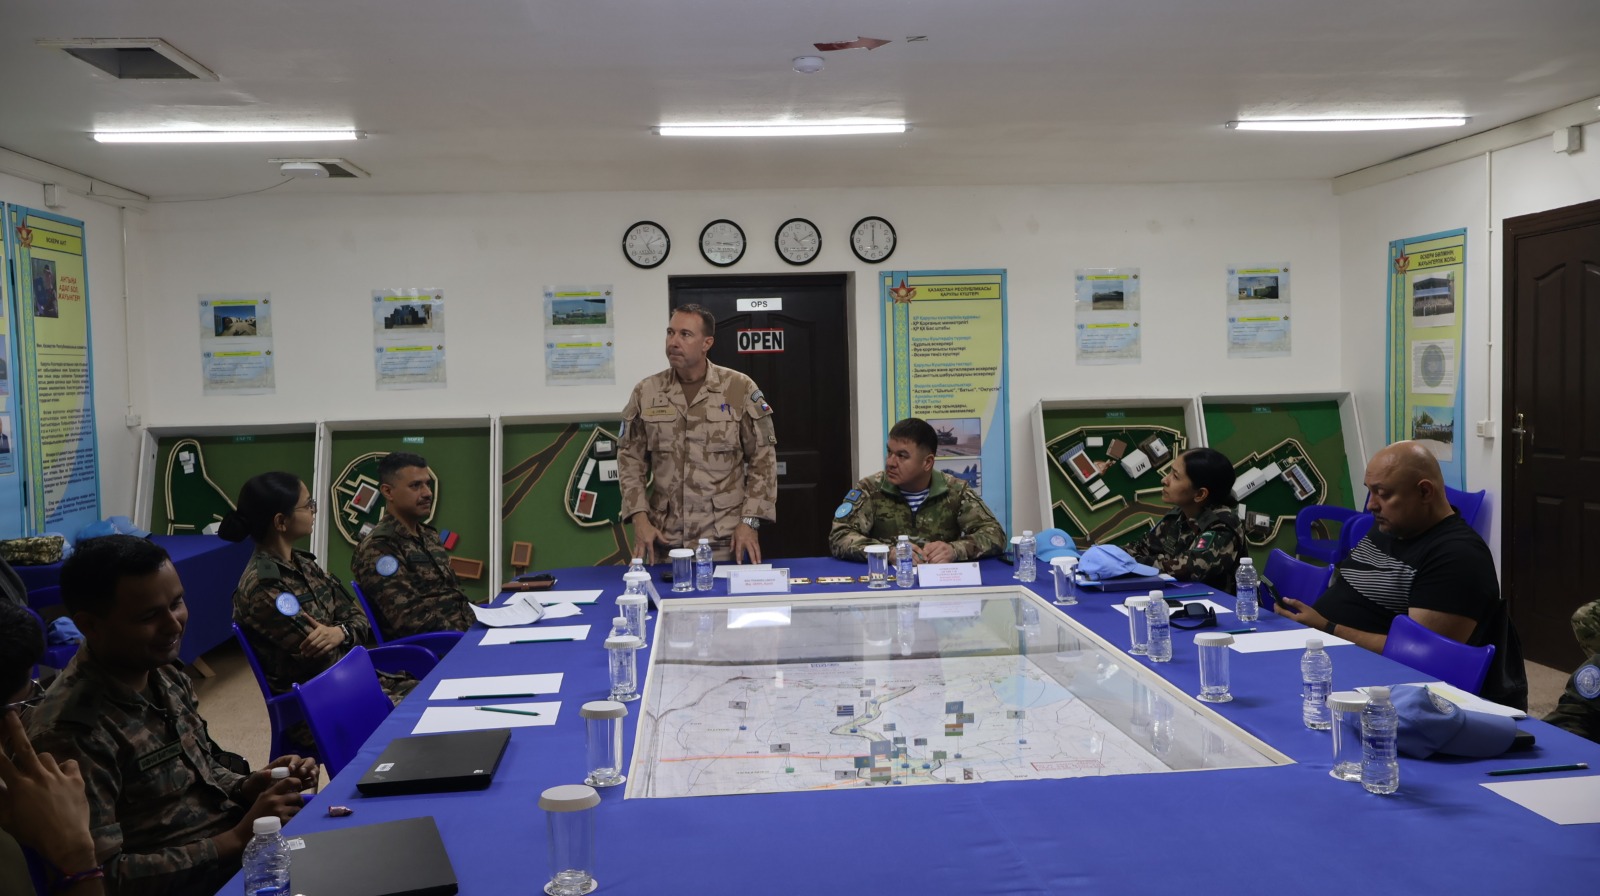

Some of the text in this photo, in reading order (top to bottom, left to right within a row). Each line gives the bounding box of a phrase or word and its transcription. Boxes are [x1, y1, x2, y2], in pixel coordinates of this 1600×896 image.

[739, 332, 782, 350] OPEN
[1136, 462, 1146, 472] UN
[608, 470, 618, 479] UN
[1246, 481, 1256, 490] UN
